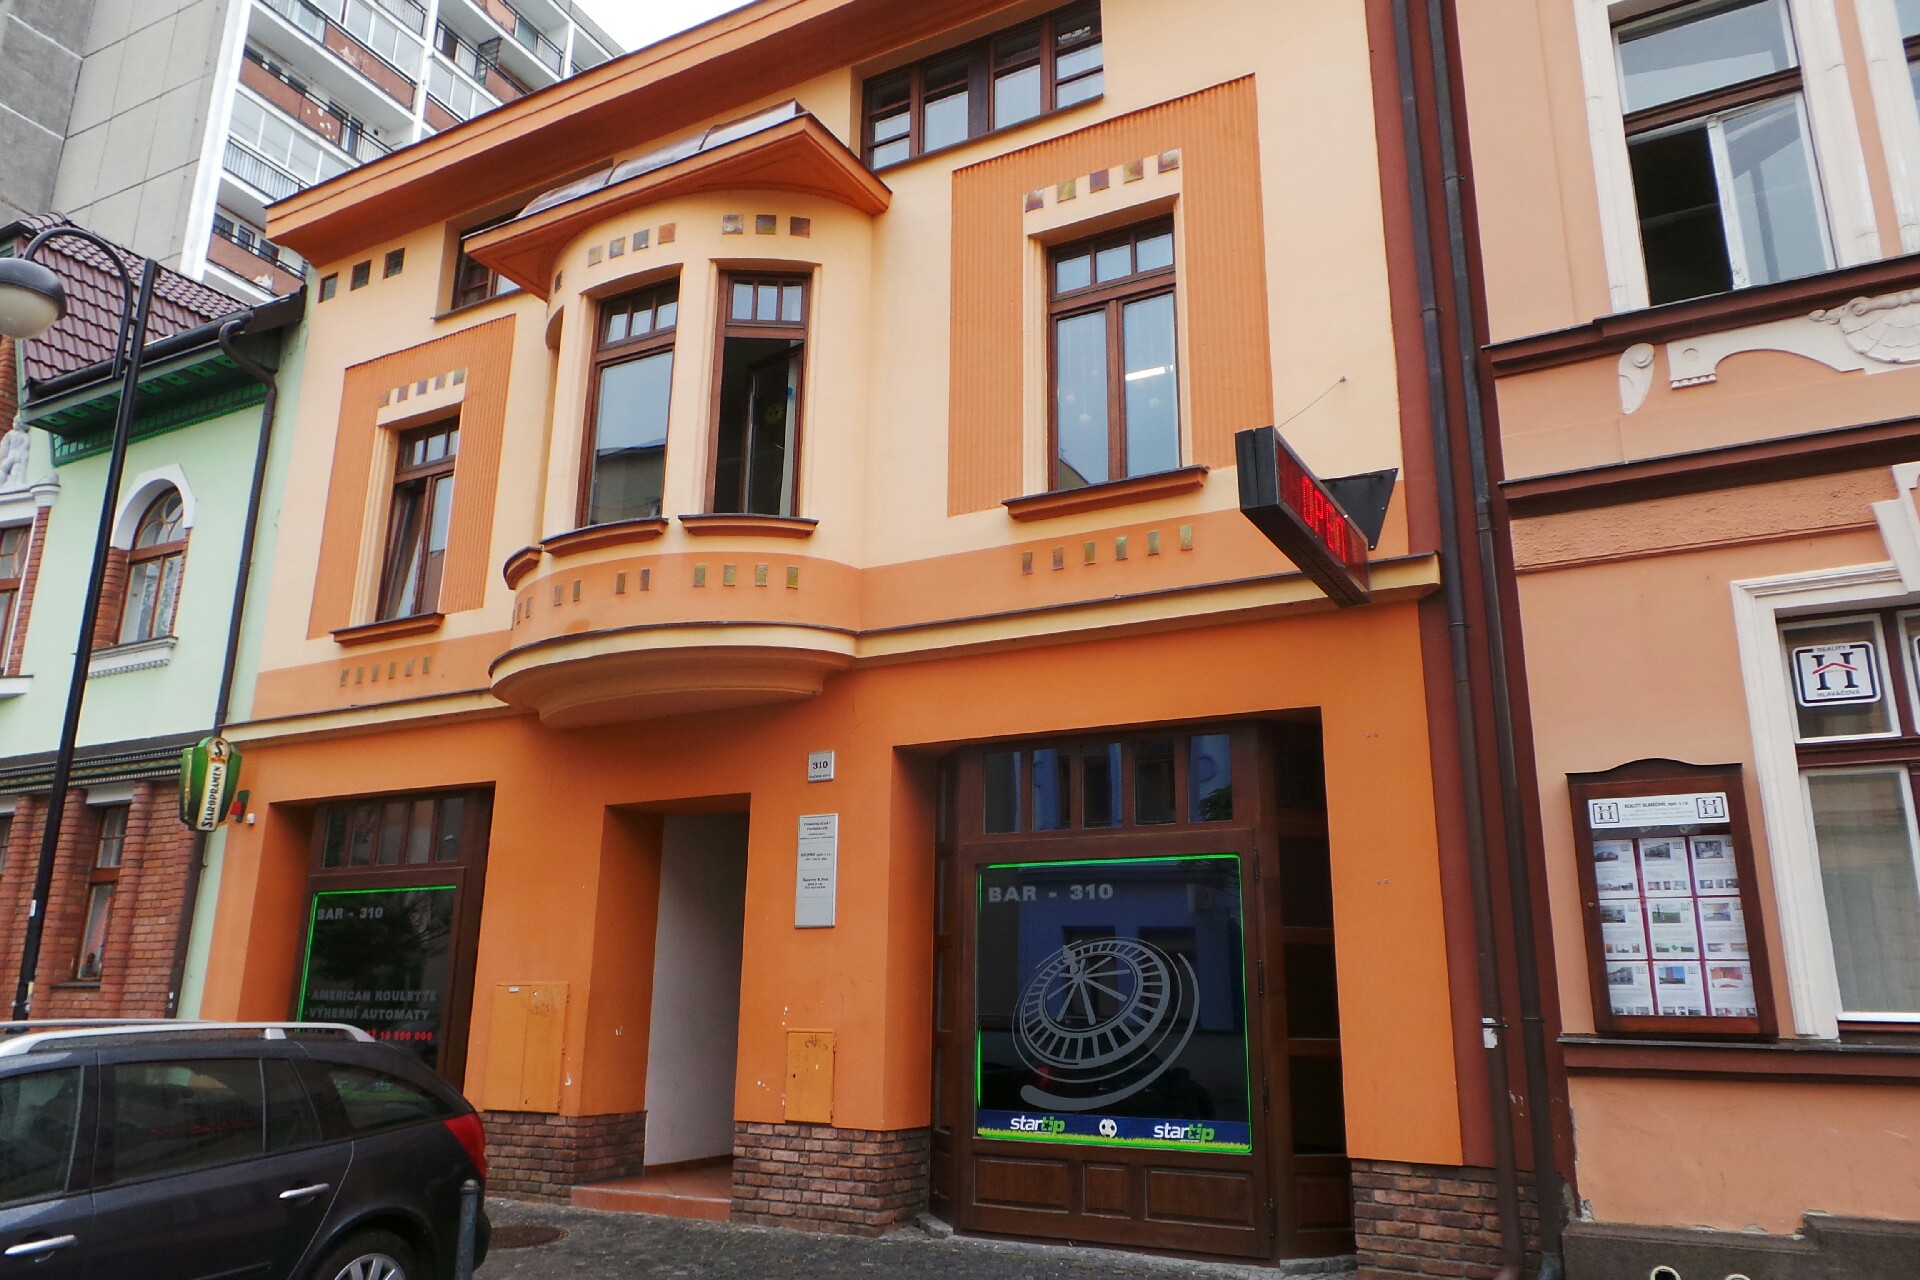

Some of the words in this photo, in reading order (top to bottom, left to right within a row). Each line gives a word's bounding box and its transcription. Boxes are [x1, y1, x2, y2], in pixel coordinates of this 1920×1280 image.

[1816, 645, 1847, 653] REALITY
[812, 760, 829, 770] 310
[201, 765, 222, 828] STAROPRAMEN
[988, 885, 1037, 903] BAR
[1069, 883, 1114, 900] 310
[317, 907, 344, 920] BAR
[360, 907, 384, 919] 310
[309, 990, 371, 1001] AMERICAN
[375, 990, 438, 1001] ROULETTE
[361, 1009, 431, 1020] AUTOMATY
[1010, 1115, 1065, 1135] startip
[1153, 1122, 1215, 1143] startip
